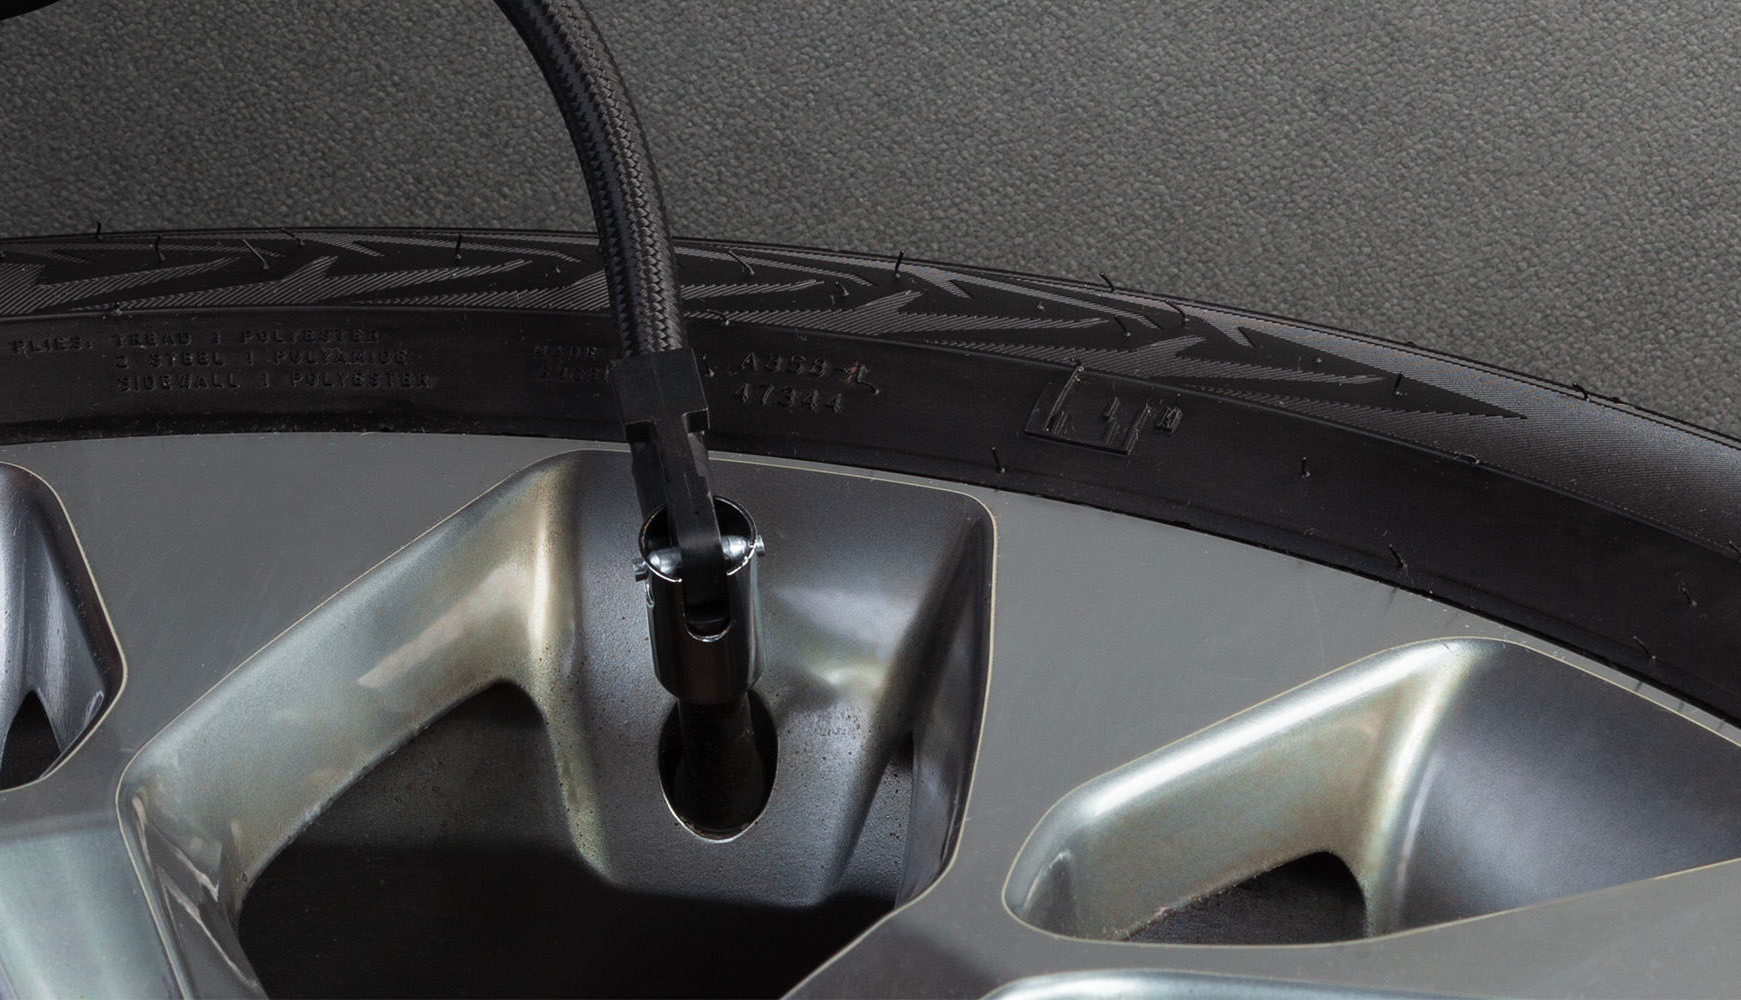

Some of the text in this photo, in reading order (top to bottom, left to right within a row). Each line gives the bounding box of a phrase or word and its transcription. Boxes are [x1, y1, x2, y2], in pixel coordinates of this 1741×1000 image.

[112, 331, 192, 348] TREAD
[242, 329, 380, 344] POLYESTER
[115, 354, 129, 369] 2
[148, 352, 225, 368] STEEL
[274, 349, 408, 365] POLYAMIDE
[117, 373, 240, 392] SIDEWALL
[291, 371, 430, 388] POLYESTER
[733, 383, 843, 413] 47344
